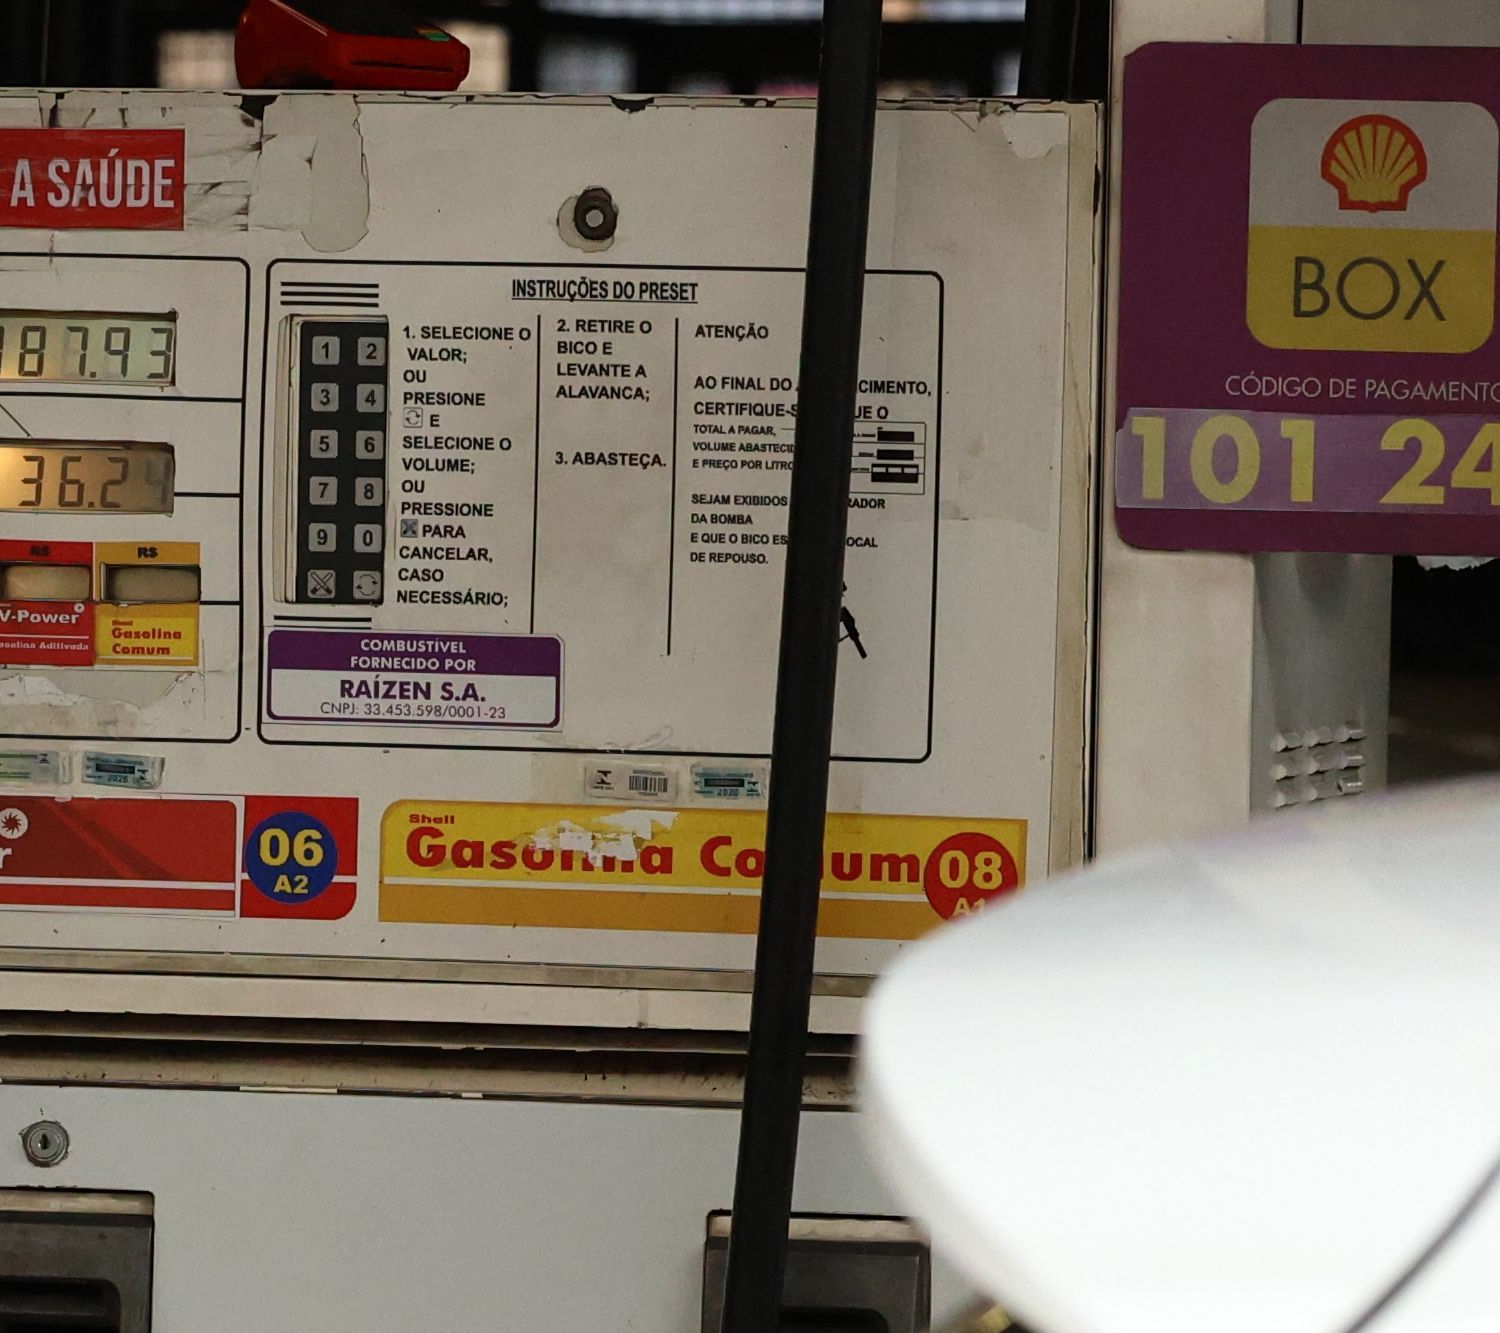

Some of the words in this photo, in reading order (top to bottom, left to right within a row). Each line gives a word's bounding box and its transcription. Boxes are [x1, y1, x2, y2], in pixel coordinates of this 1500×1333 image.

[10, 158, 35, 207] A
[47, 148, 175, 208] SAÚDE
[512, 276, 609, 302] INSTRUÇÕES
[613, 281, 636, 300] DO
[639, 281, 698, 301] PRESET
[1294, 256, 1446, 321] BOX
[421, 326, 514, 341] SELECIONE
[519, 327, 532, 341] O
[575, 319, 635, 334] RETIRE
[639, 320, 653, 334] O
[694, 321, 770, 342] ATENÇÃO
[321, 343, 331, 360] 1
[366, 343, 377, 361] 2
[408, 348, 468, 364] VALOR;
[557, 341, 598, 356] BICO
[602, 341, 613, 356] E
[403, 369, 427, 384] OU
[556, 363, 632, 378] LEVANTE
[634, 364, 647, 379] A
[694, 376, 717, 391] AO
[721, 376, 766, 391] FINAL
[770, 377, 793, 392] DO
[1225, 371, 1322, 398] CÓDIGO
[1329, 378, 1357, 399] DE
[320, 389, 331, 406] 3
[365, 389, 377, 407] 4
[403, 392, 486, 407] PRESIONE
[555, 385, 650, 403] ALAVANCA;
[693, 424, 726, 435] TOTAL
[319, 435, 330, 452] 5
[364, 436, 375, 453] 6
[402, 436, 494, 451] SELECIONE
[402, 458, 475, 474] VOLUME;
[572, 452, 667, 470] ABASTEÇA.
[1132, 414, 1315, 504] 101
[318, 482, 329, 500] 7
[363, 482, 375, 501] 8
[401, 480, 425, 494] OU
[401, 502, 494, 518] PRESSIONE
[316, 528, 328, 547] 9
[362, 529, 373, 547] 0
[422, 525, 466, 539] PARA
[399, 546, 494, 563] CANCELAR,
[397, 568, 444, 583] CASO
[396, 590, 509, 609] NECESSÁRIO;
[360, 638, 466, 654] COMBUSTÍVEL
[350, 656, 440, 671] FORNECIDO
[445, 658, 476, 672] POR
[340, 674, 431, 701] RAÍZEN
[440, 682, 487, 702] S.A.
[320, 702, 359, 716] CNPJ:
[408, 813, 455, 825] Shell
[259, 828, 323, 867] 06
[406, 826, 673, 875] Gasoa
[701, 835, 920, 883] Coum
[939, 849, 1003, 890] 08
[274, 874, 309, 895] A2
